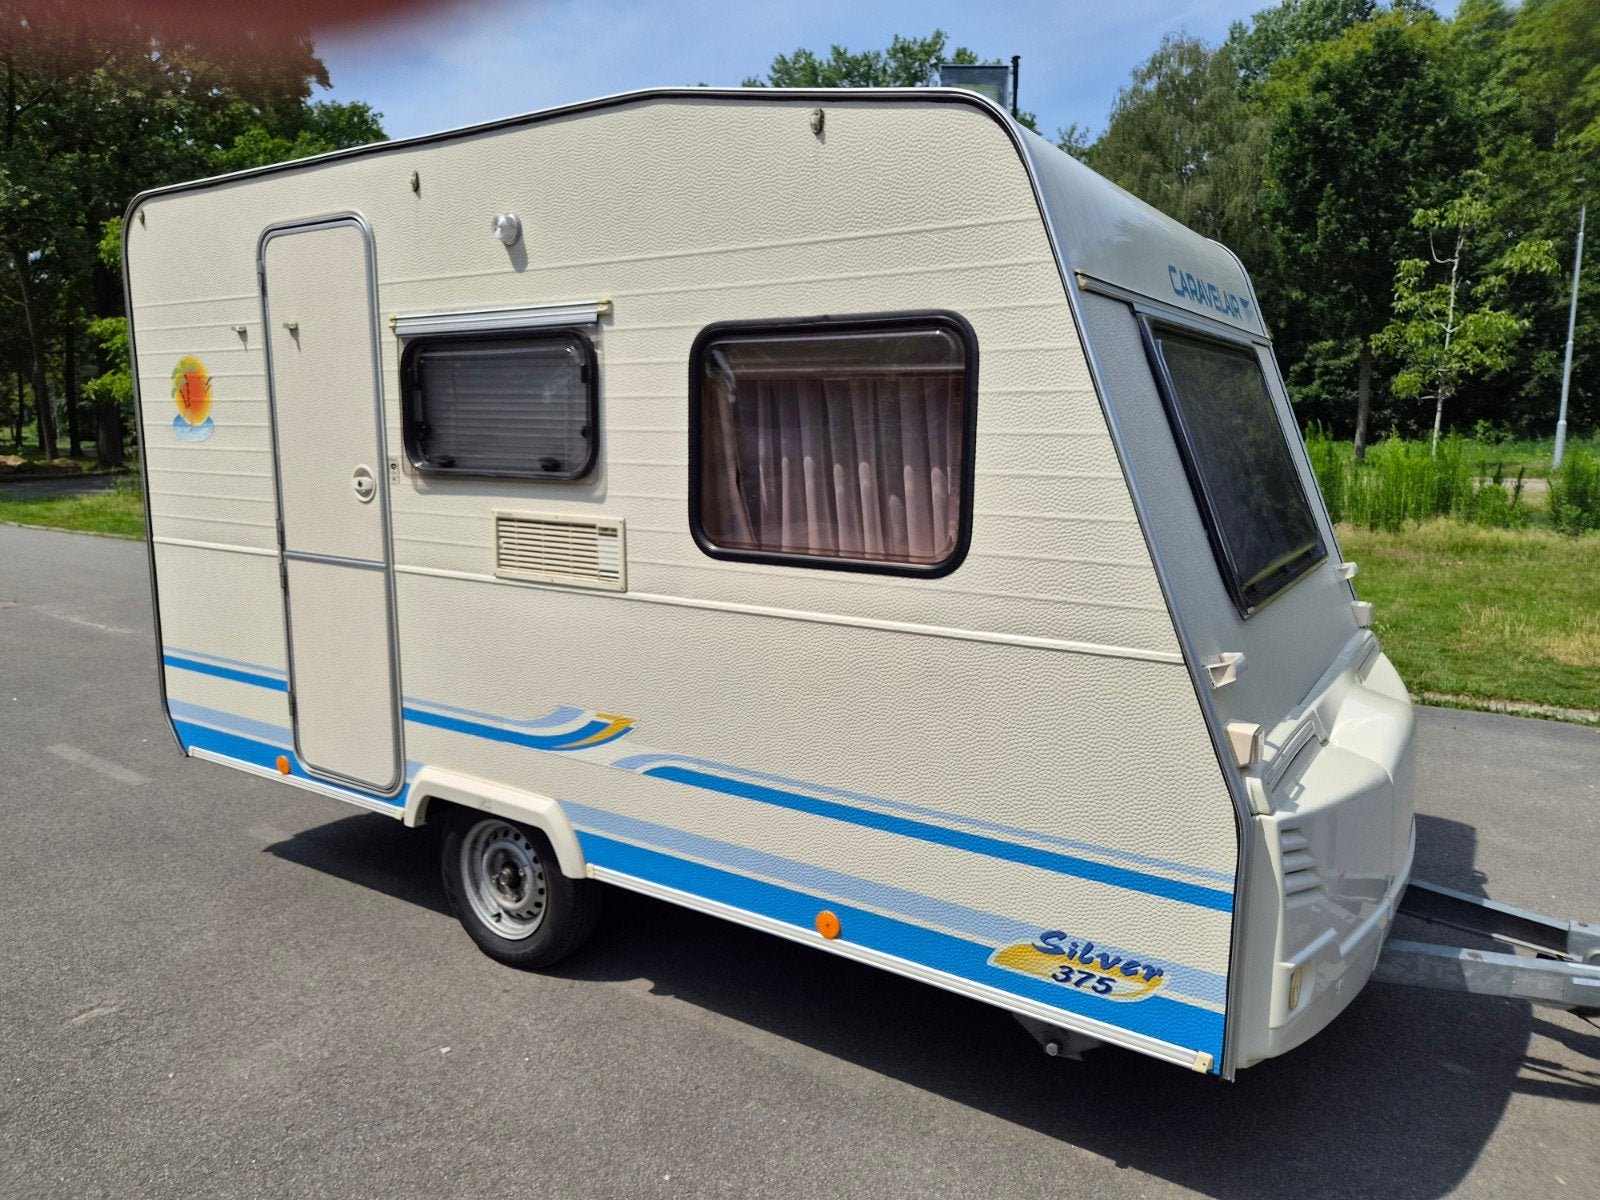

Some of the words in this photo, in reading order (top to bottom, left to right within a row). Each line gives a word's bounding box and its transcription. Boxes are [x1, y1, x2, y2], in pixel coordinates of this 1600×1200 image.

[1168, 265, 1243, 320] CARAVELAIR
[1032, 930, 1164, 982] Silver
[1051, 965, 1117, 995] 375
